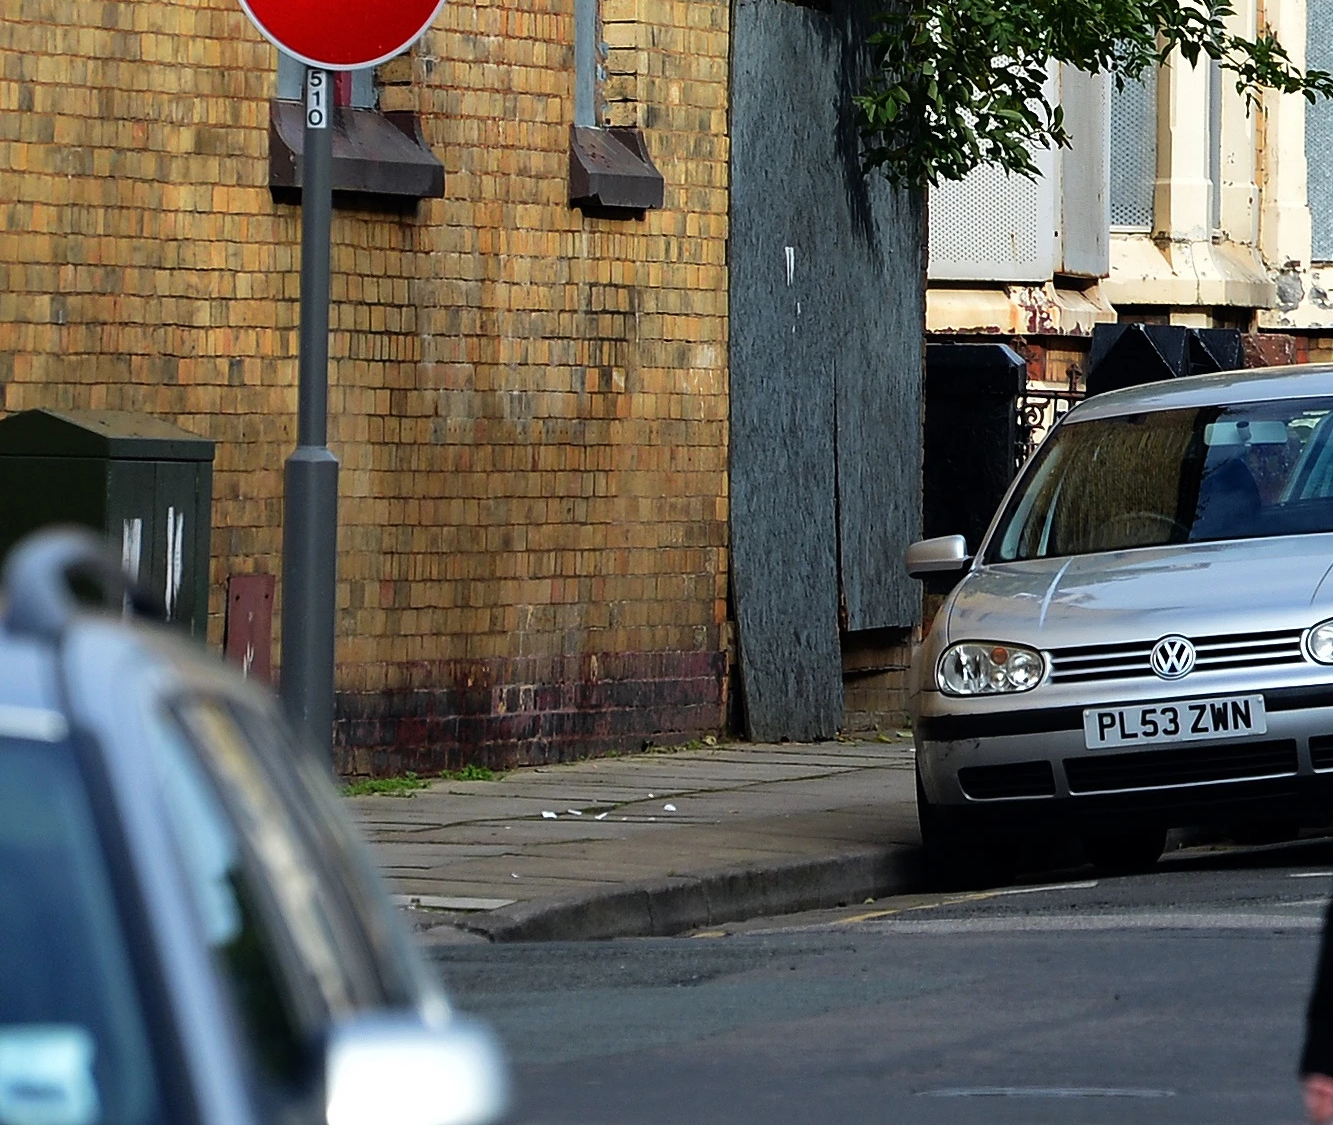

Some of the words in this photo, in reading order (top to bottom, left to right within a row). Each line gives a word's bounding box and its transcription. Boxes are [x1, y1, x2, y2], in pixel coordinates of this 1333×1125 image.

[308, 70, 323, 126] 510
[1097, 706, 1180, 742] PL53
[1188, 699, 1252, 735] ZWN
